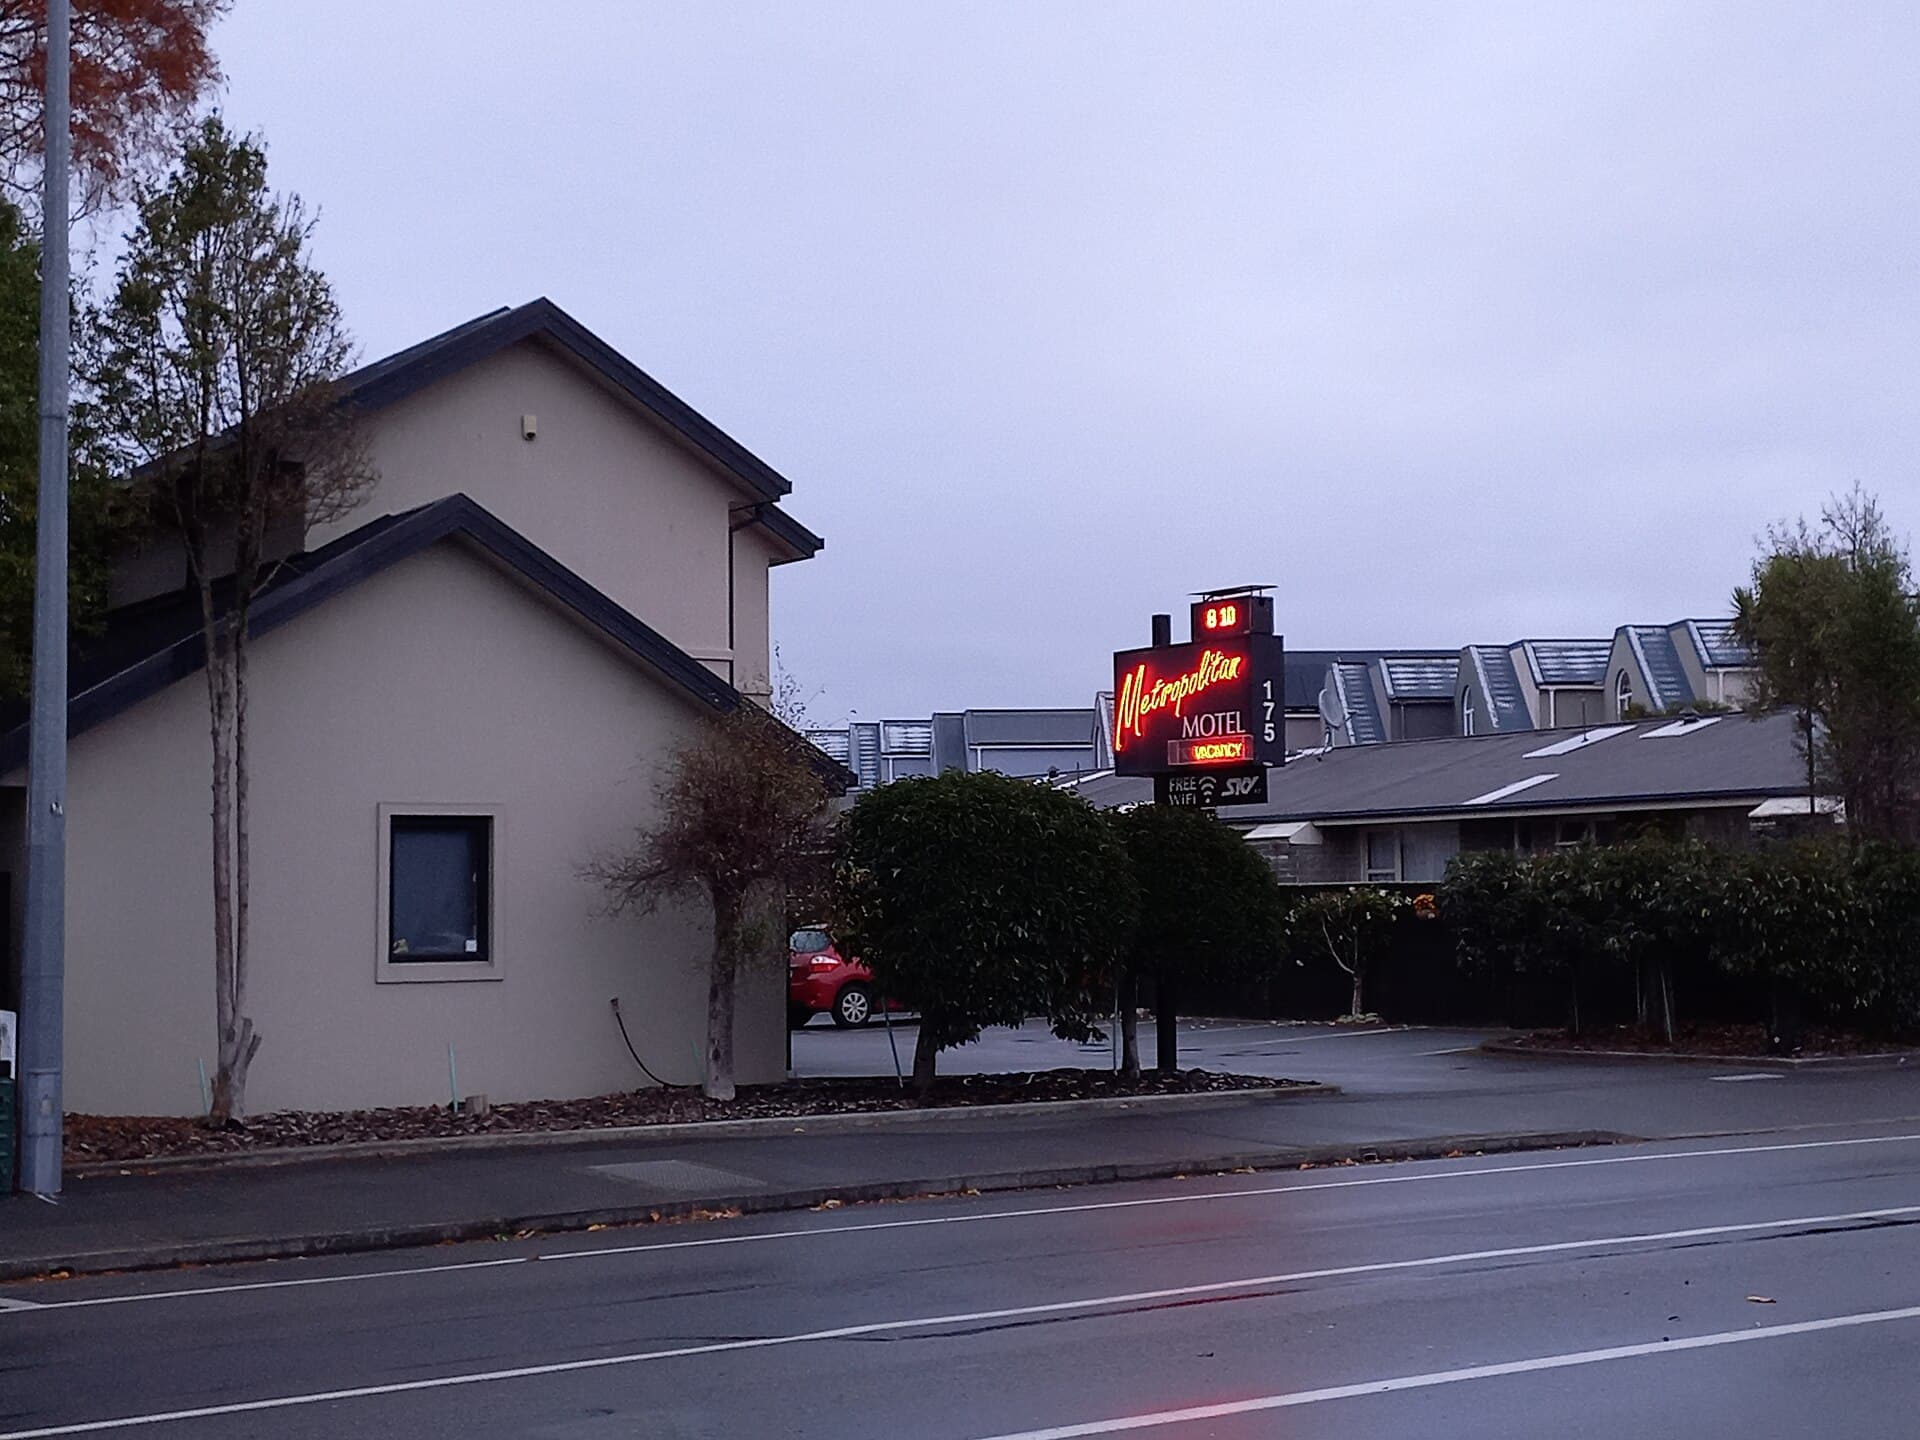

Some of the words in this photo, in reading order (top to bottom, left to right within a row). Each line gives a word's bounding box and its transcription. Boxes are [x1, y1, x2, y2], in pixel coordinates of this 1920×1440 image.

[1115, 650, 1241, 752] Metropolitan
[1263, 680, 1275, 742] 175
[1182, 711, 1246, 738] MOTEL
[1194, 742, 1243, 760] VACANCY
[1169, 776, 1197, 792] FREE
[1220, 775, 1260, 797] SKY
